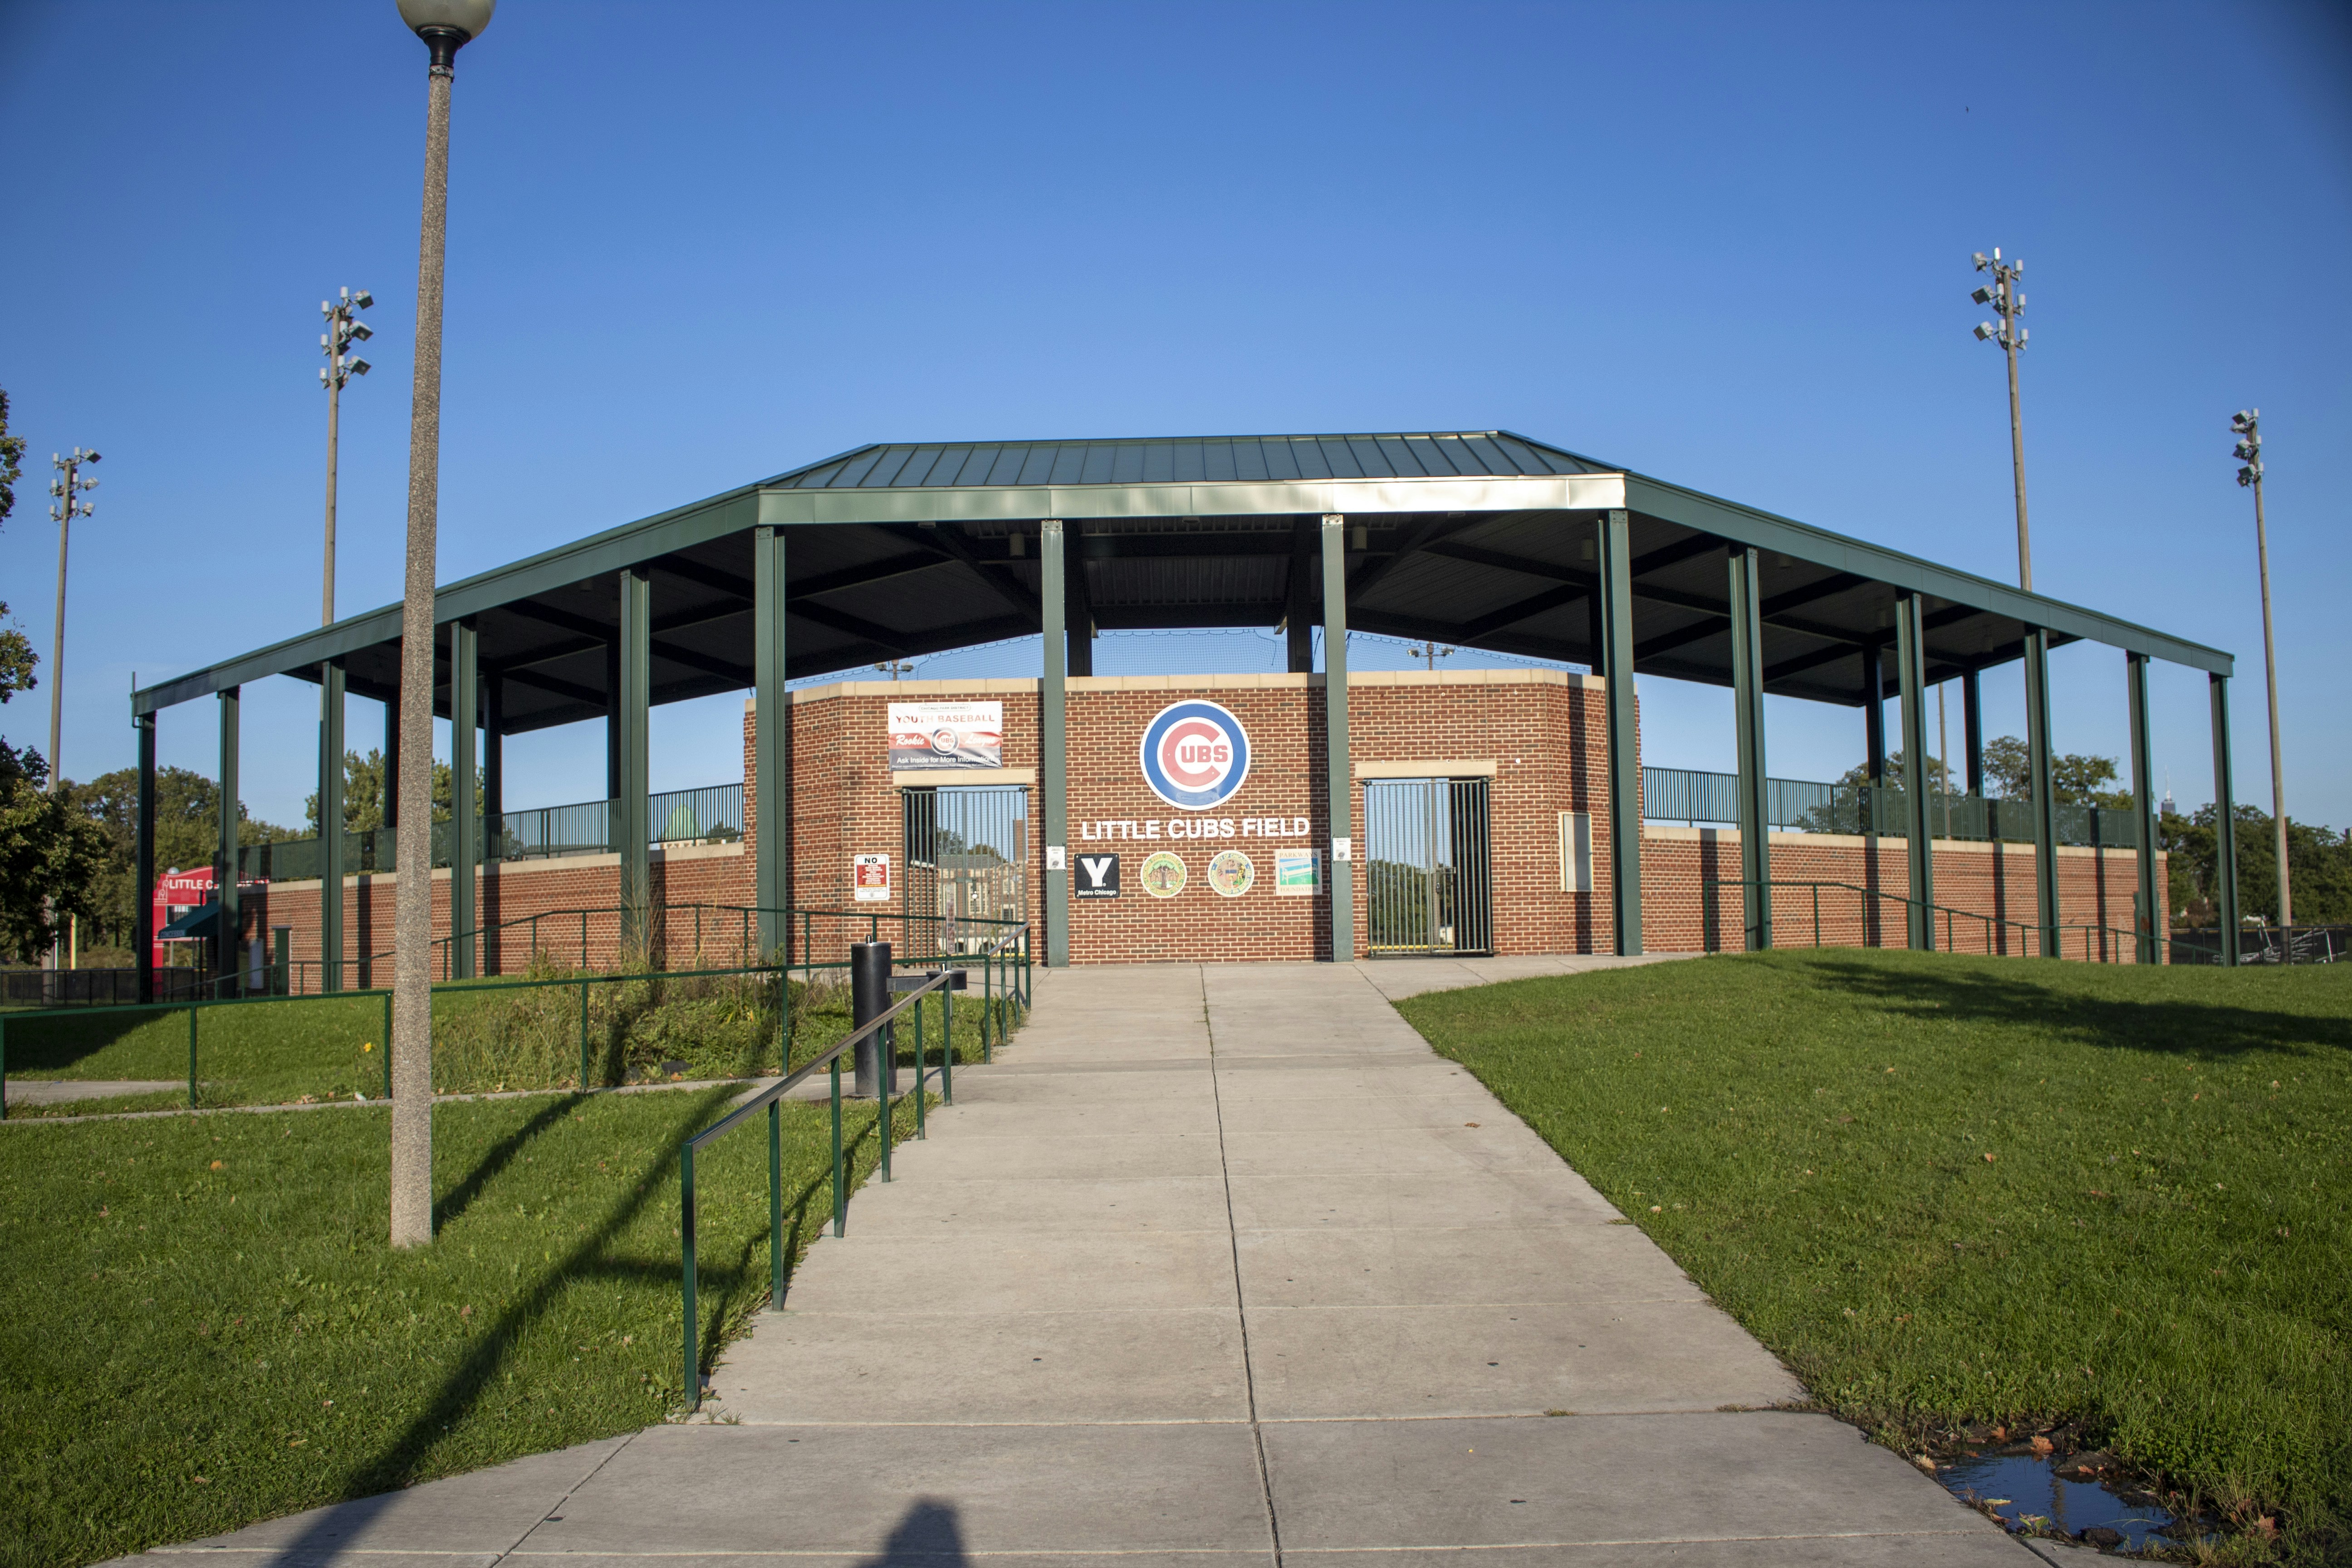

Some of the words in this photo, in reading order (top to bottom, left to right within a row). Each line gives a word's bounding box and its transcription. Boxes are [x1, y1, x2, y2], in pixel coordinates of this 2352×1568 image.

[938, 715, 995, 723] BASEBALL
[896, 734, 925, 745] Rookie
[965, 733, 996, 747] League
[1162, 722, 1229, 787] CUBS
[1082, 820, 1161, 840] LITTLE
[1168, 818, 1235, 838] CUBS
[1243, 817, 1310, 838] FIELD
[1081, 858, 1113, 887] Y
[169, 879, 203, 890] LITTLE
